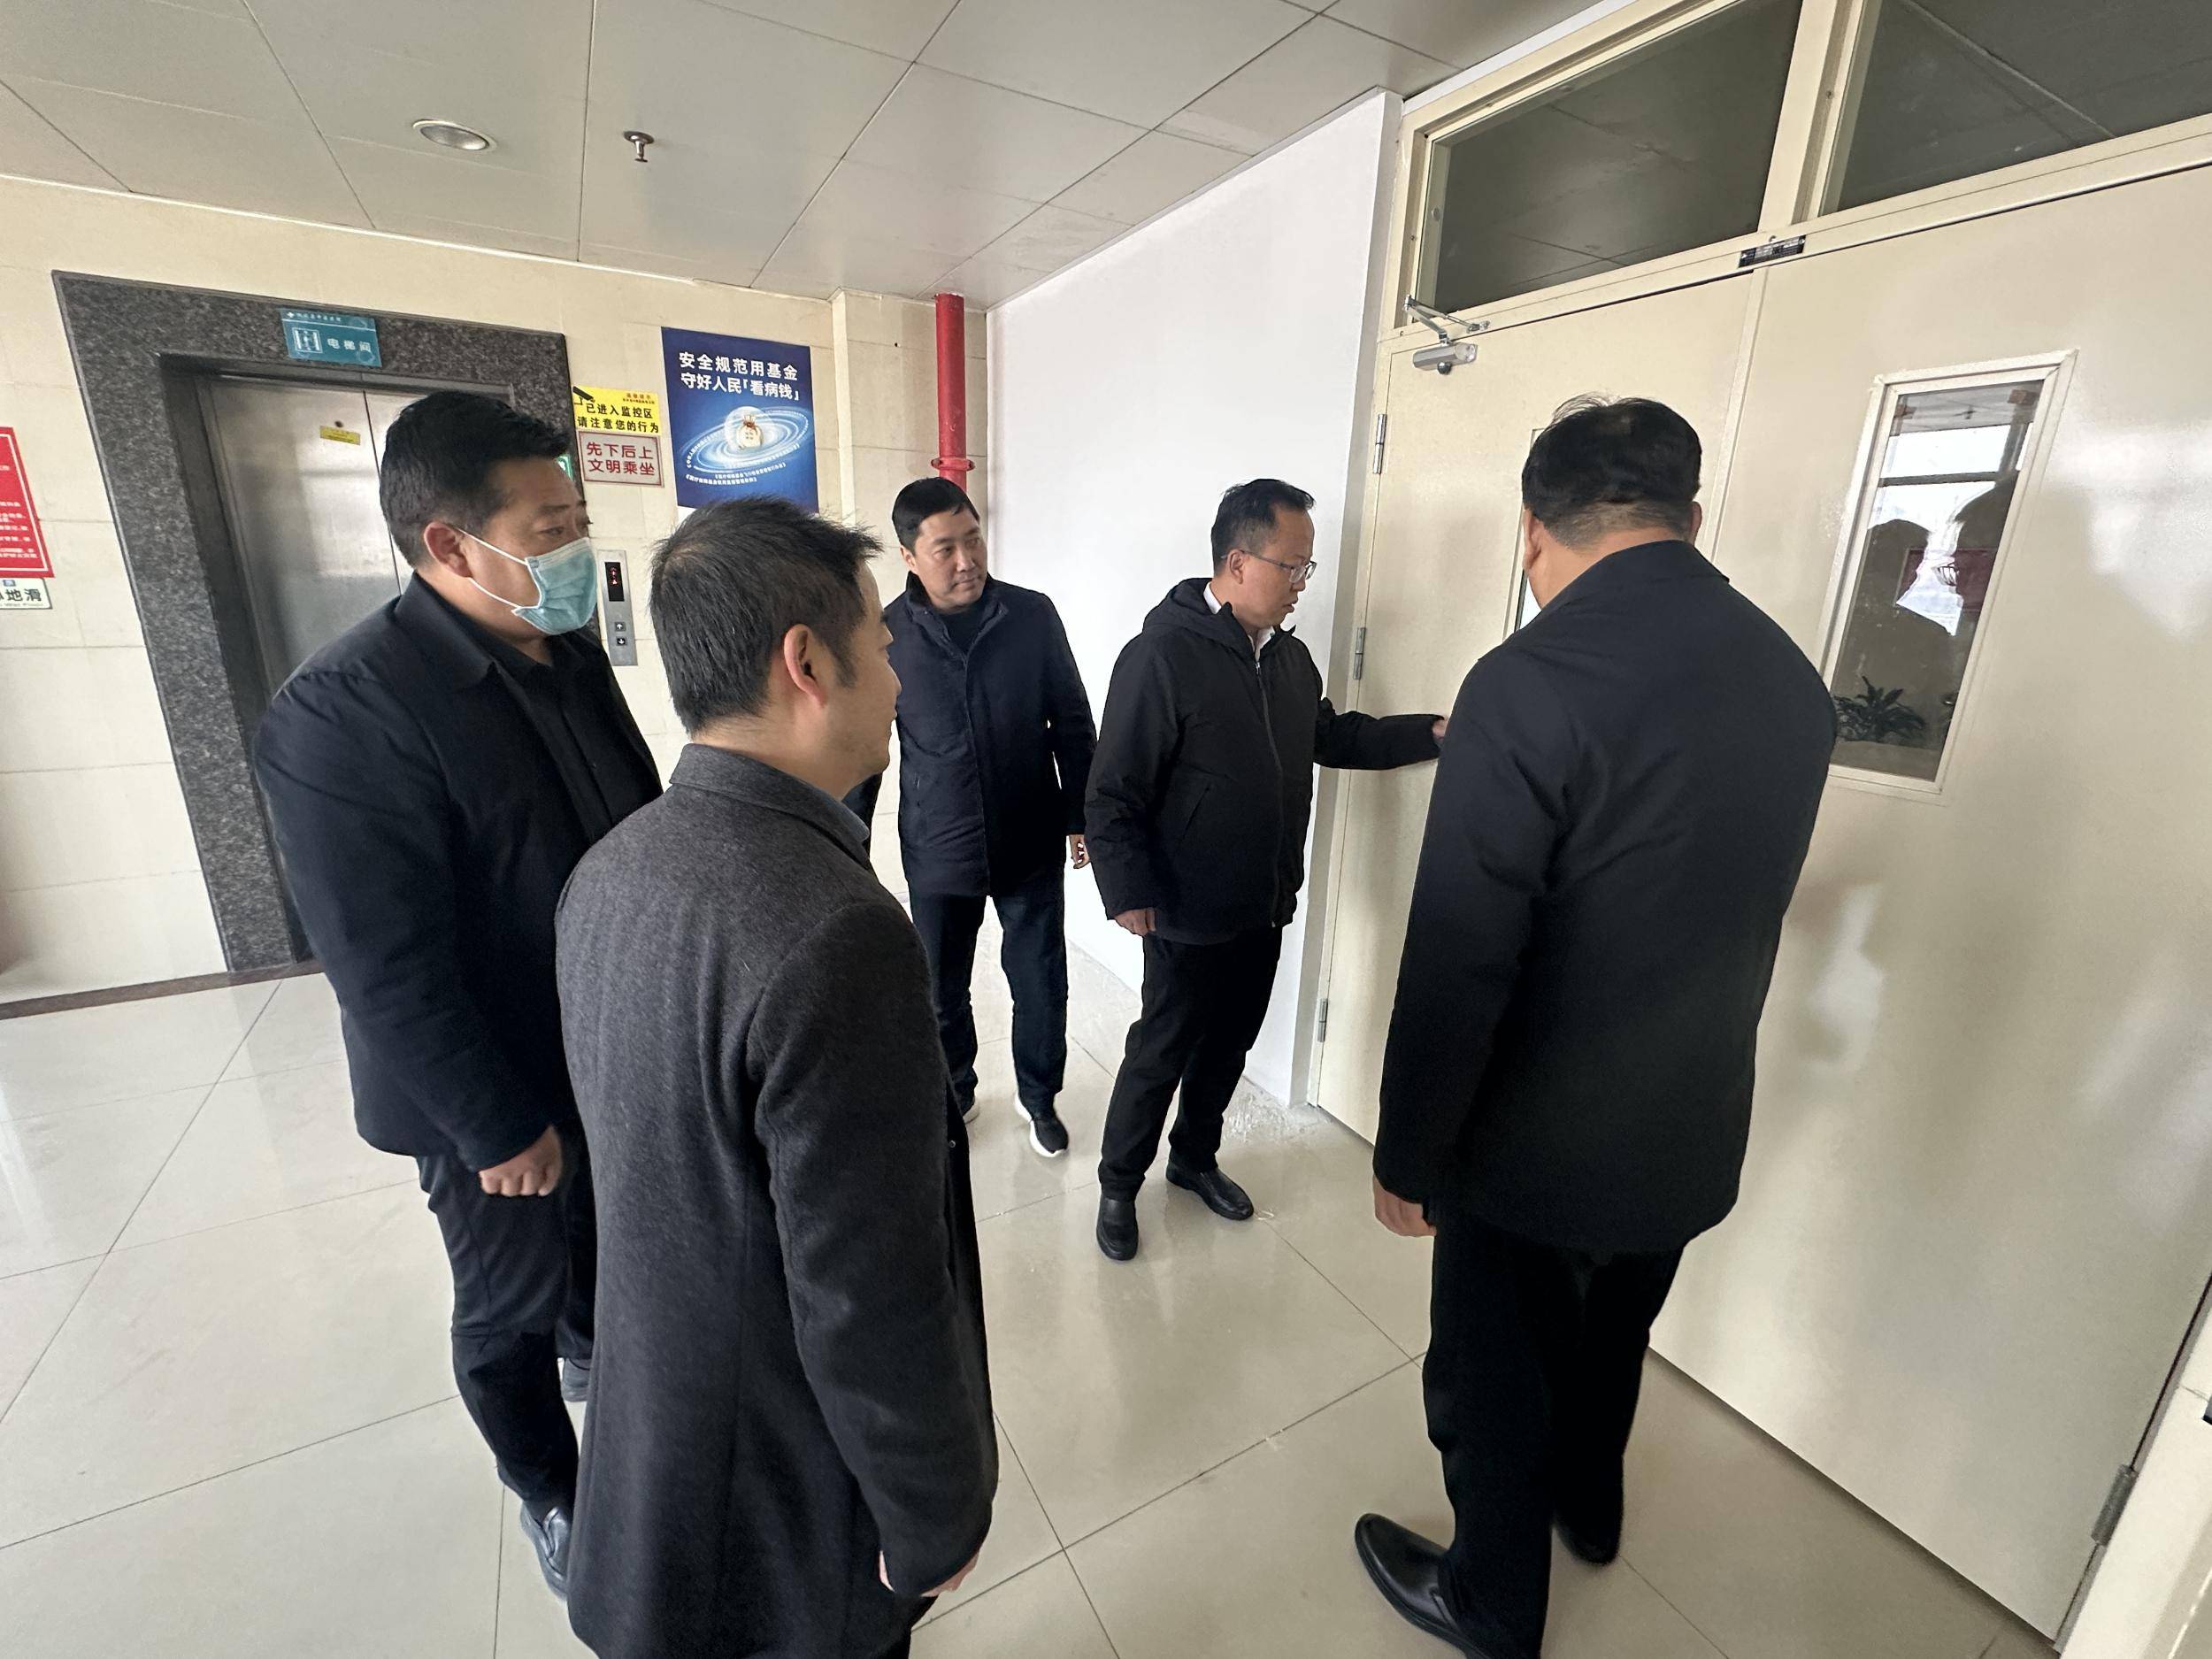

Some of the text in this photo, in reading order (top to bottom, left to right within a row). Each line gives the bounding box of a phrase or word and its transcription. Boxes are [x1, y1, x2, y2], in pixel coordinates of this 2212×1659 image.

[679, 351, 798, 381] 安全规范用基金
[586, 403, 653, 419] 已进入监控区
[577, 416, 659, 434] 请注意您的行为
[586, 442, 654, 459] 先下后上
[588, 458, 655, 476] 文明乘坐
[0, 588, 42, 602] 地滑
